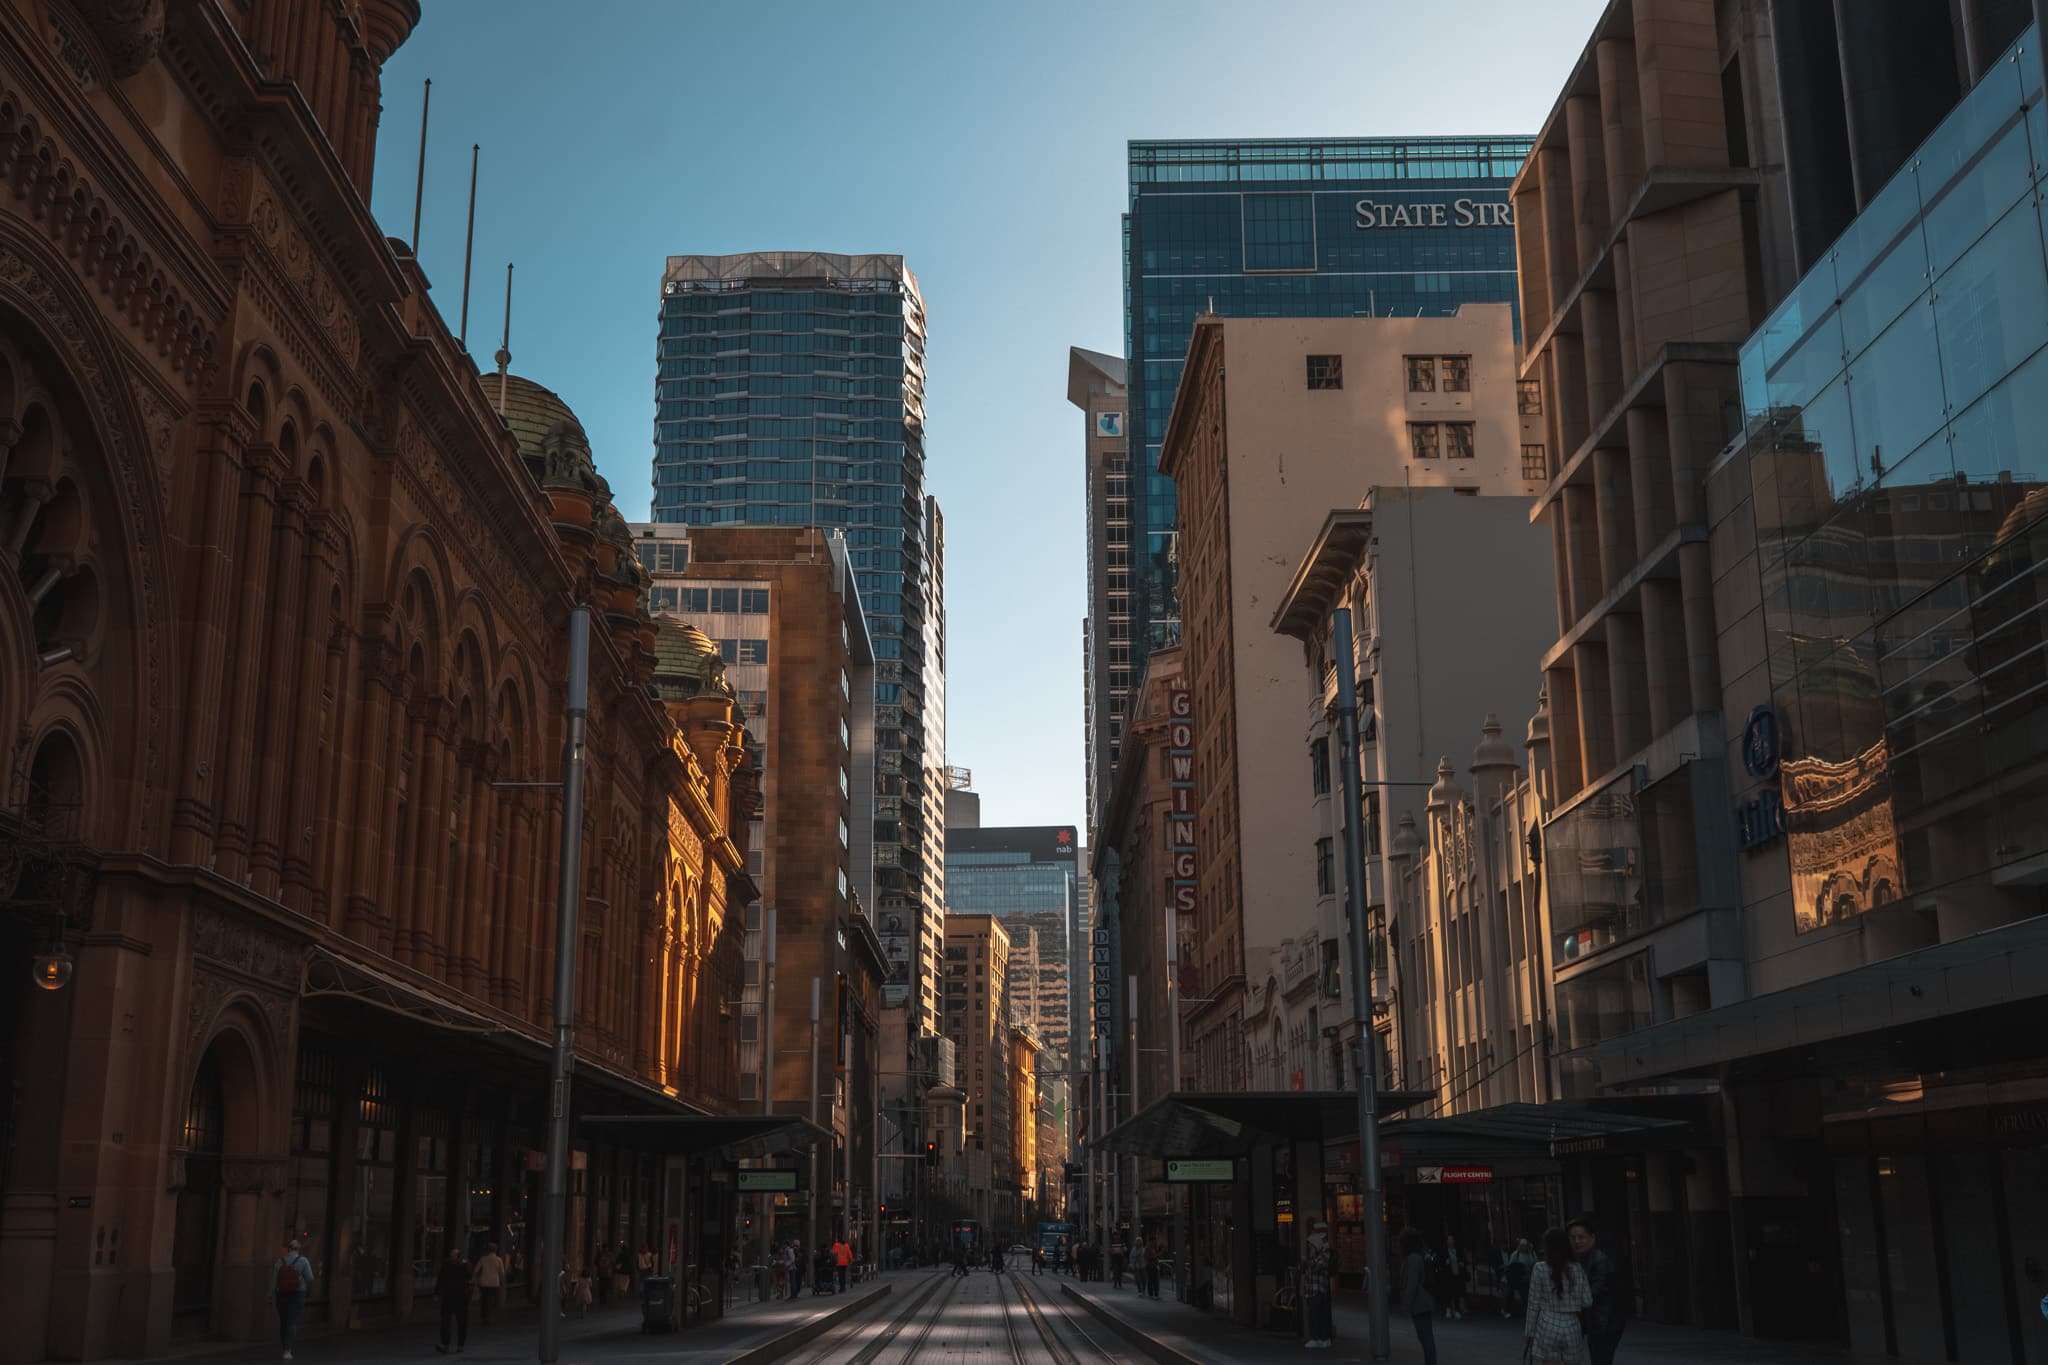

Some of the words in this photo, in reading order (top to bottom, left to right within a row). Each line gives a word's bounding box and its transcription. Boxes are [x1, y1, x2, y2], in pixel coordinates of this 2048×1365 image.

[1355, 199, 1447, 228] STATE
[1454, 198, 1515, 227] STR
[1171, 692, 1196, 911] GOWINGS
[1056, 845, 1072, 854] nab
[1096, 930, 1110, 1051] DYMOCK
